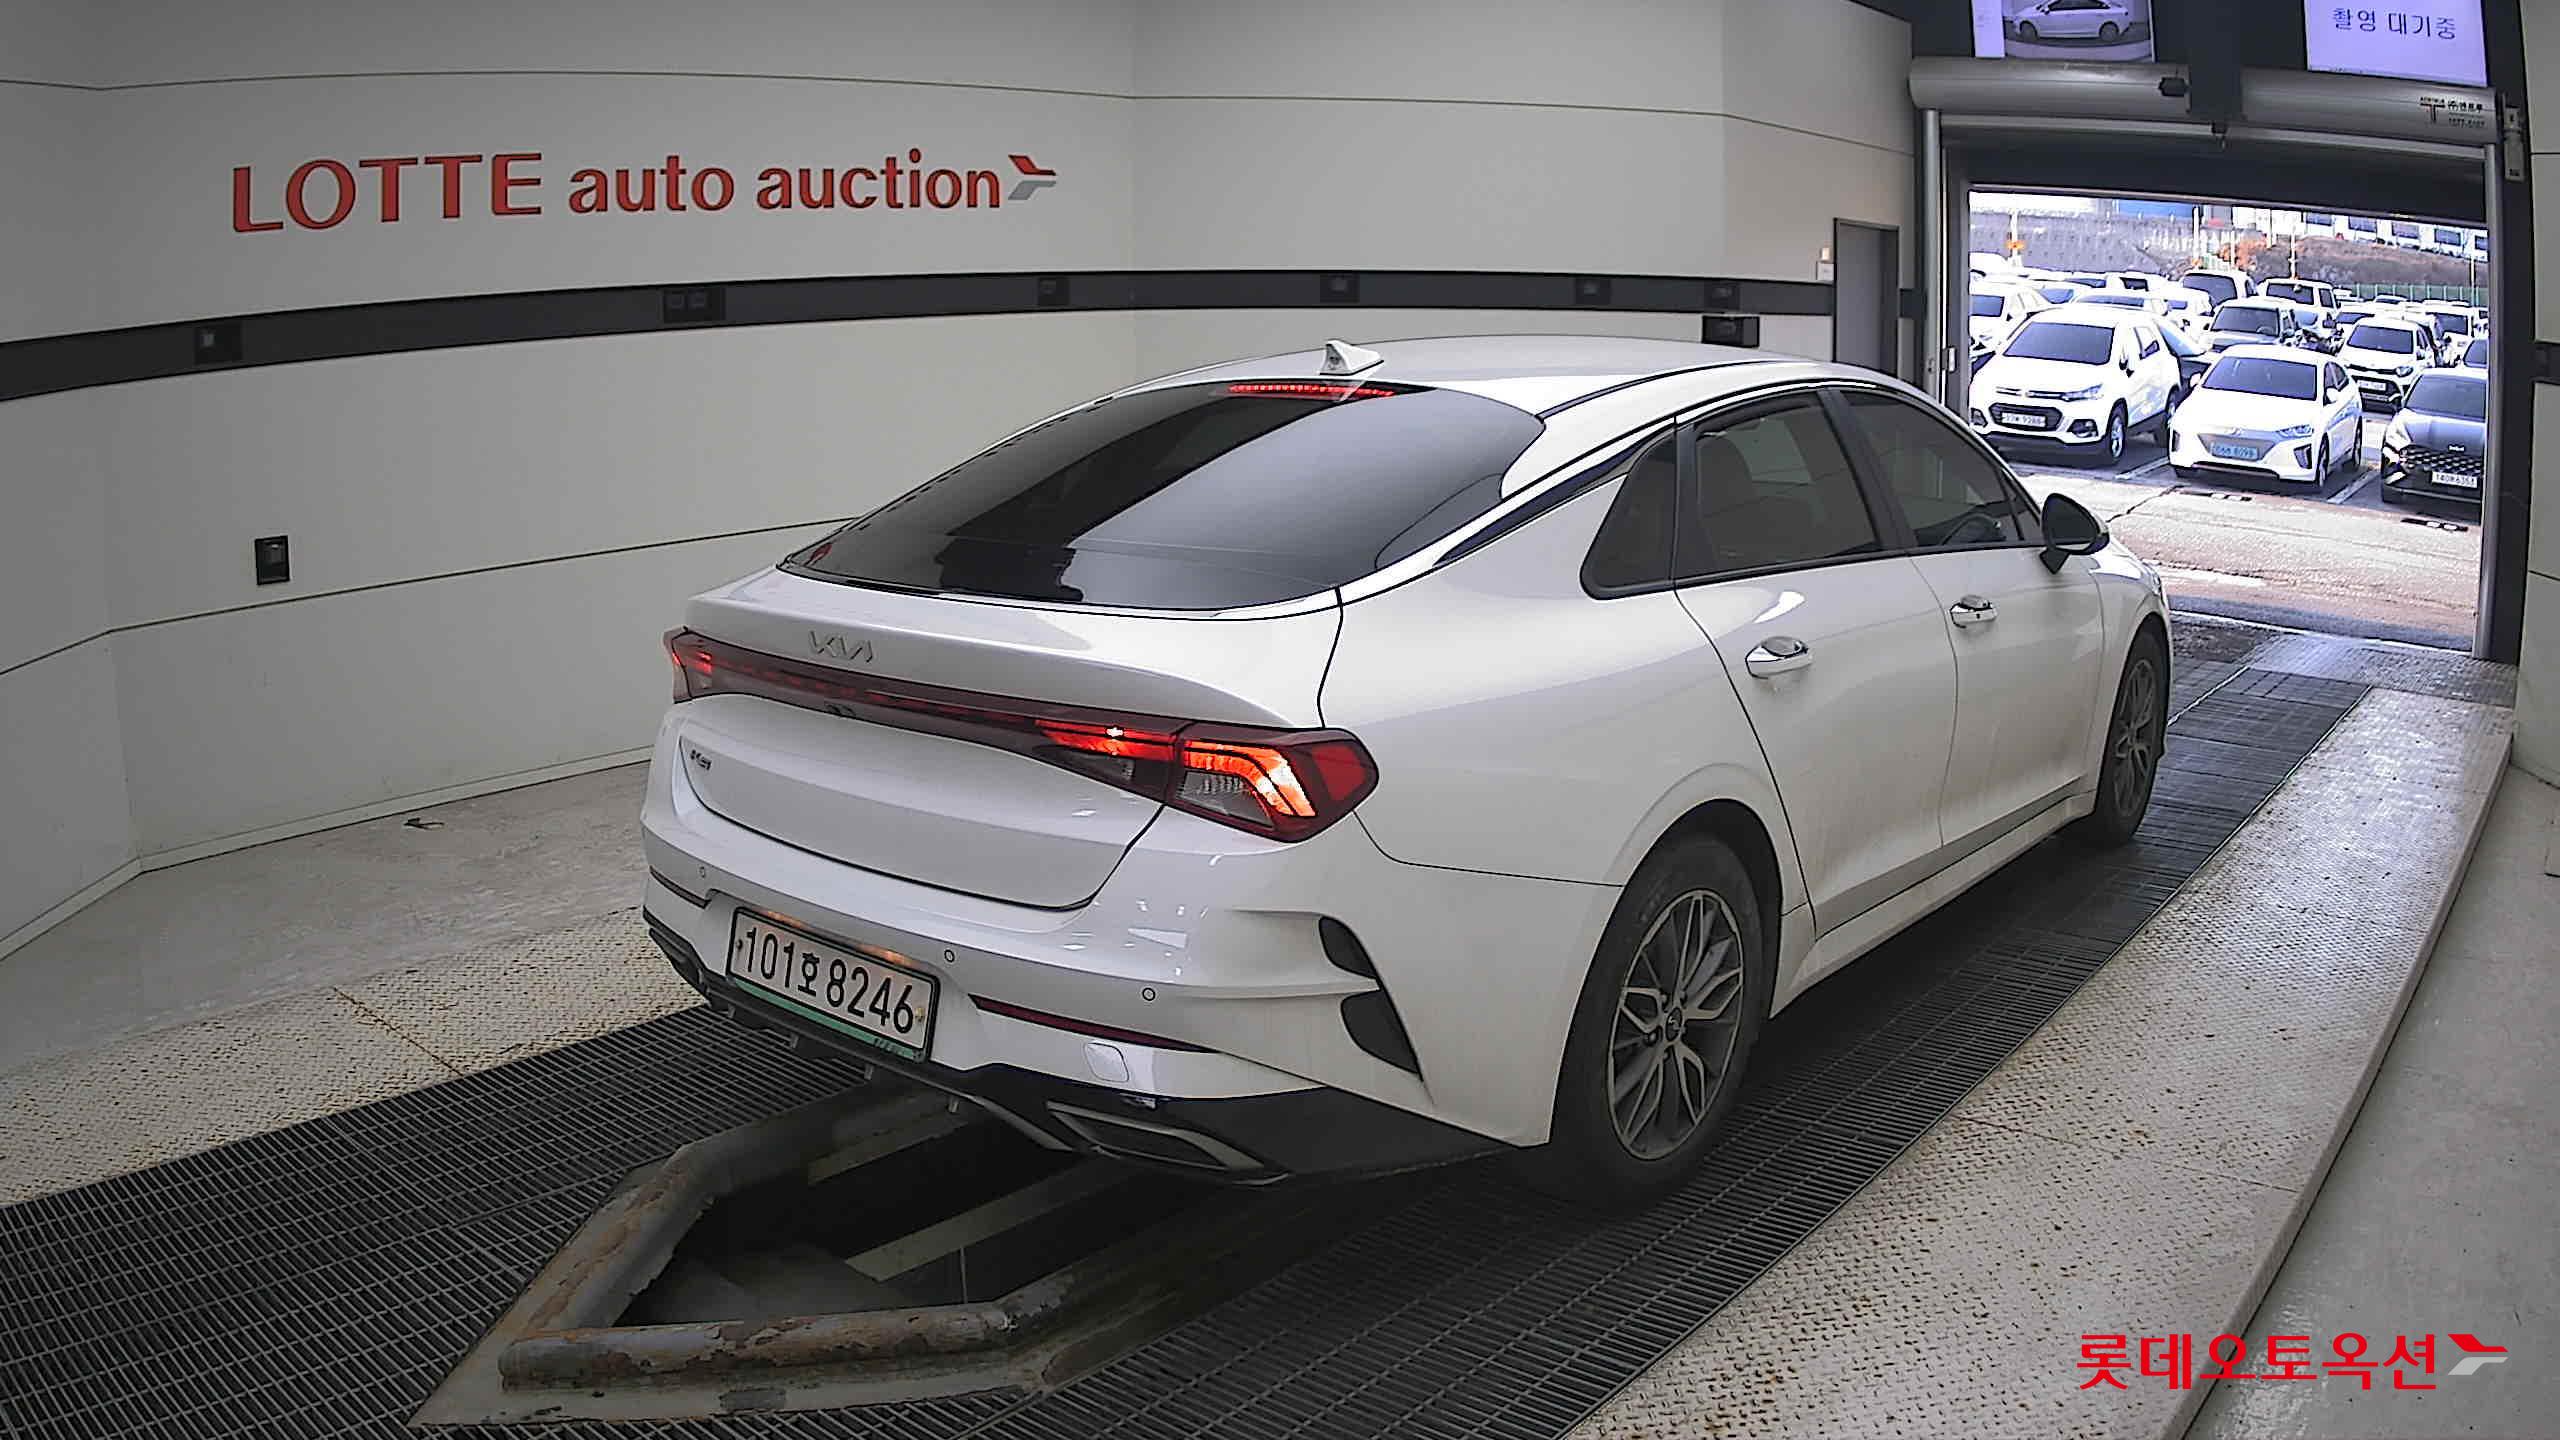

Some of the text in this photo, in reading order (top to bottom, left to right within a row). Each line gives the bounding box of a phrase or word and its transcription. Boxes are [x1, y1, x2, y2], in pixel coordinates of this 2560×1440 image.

[2333, 7, 2457, 41] 촬영 대기중
[233, 150, 1003, 233] LOTTE auto auction
[807, 630, 874, 663] KIA
[746, 927, 914, 1034] 101호8246
